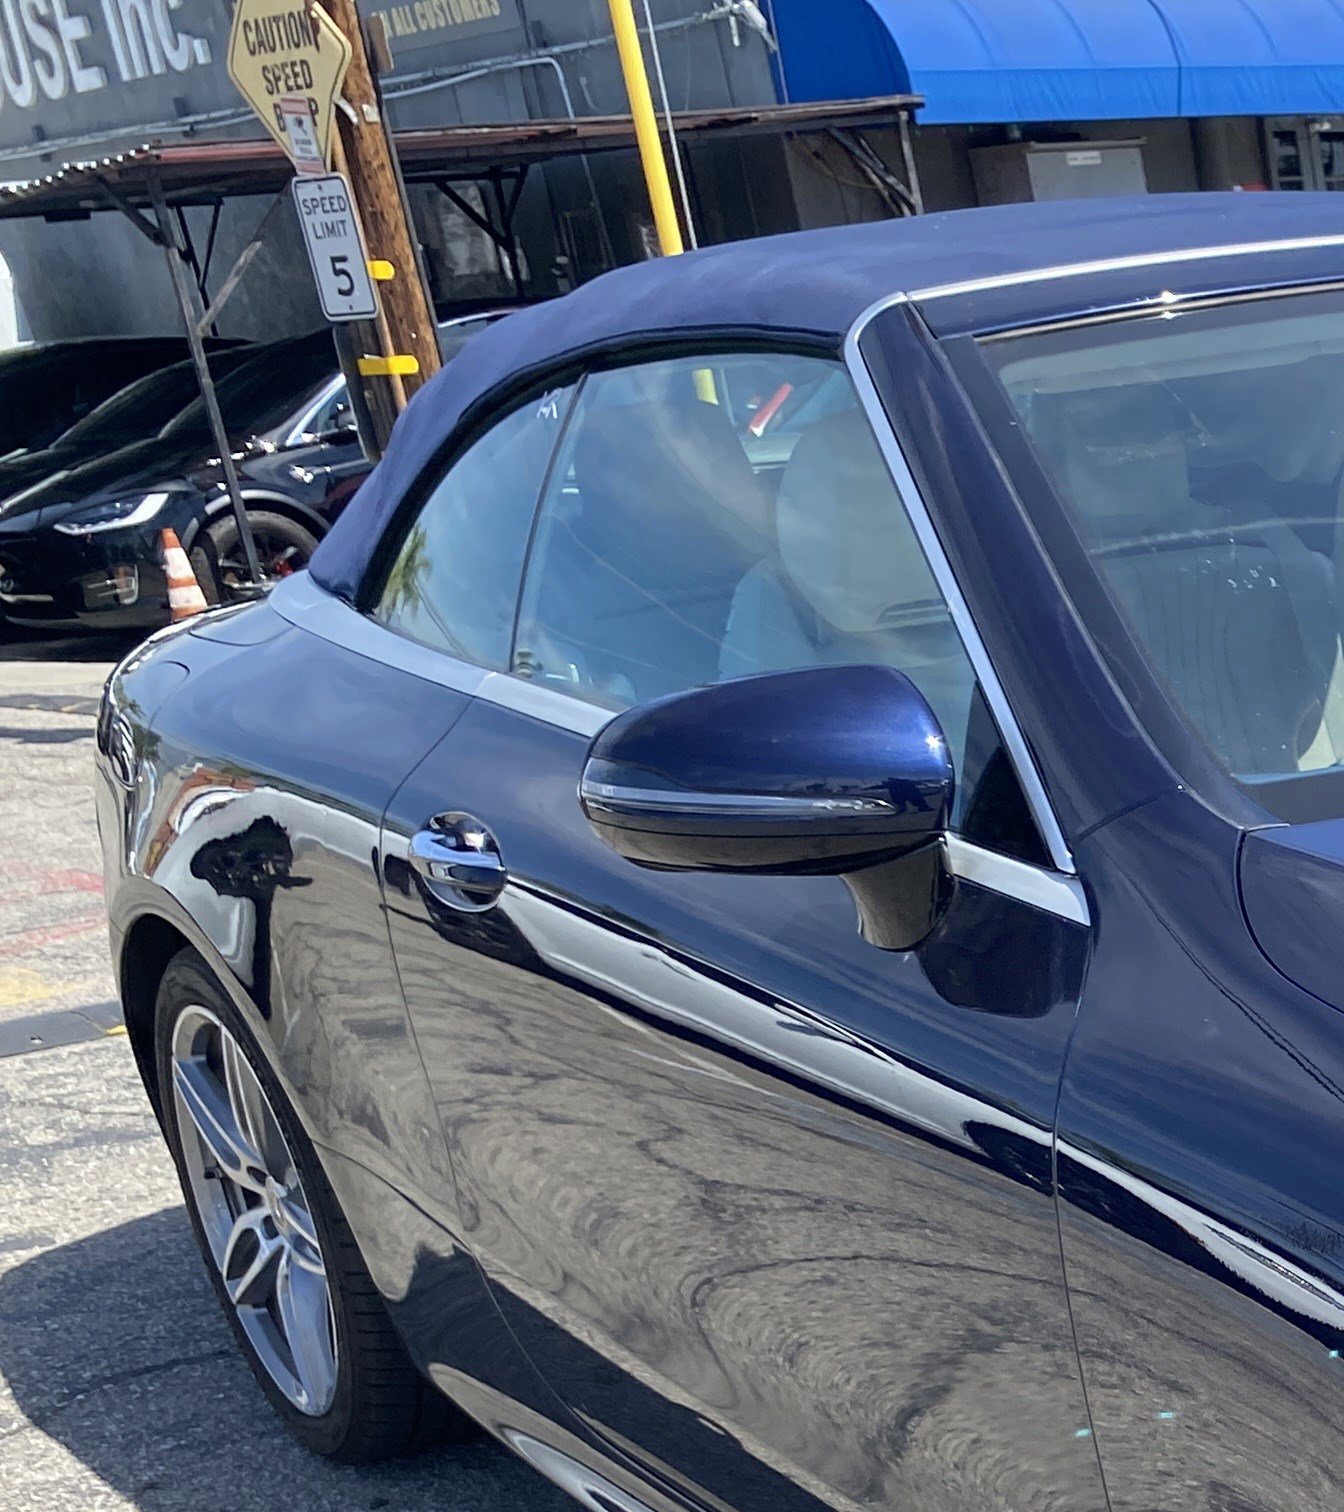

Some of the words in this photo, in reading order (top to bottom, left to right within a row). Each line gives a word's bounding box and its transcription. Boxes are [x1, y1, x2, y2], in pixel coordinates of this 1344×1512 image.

[242, 10, 316, 57] CAUTION
[414, 0, 500, 31] CUSTOMERS
[0, 0, 107, 108] USE
[261, 59, 314, 95] SPEED
[272, 97, 320, 133] BP
[301, 195, 348, 216] SPEED
[311, 219, 349, 240] LIMIT
[329, 254, 355, 298] 5
